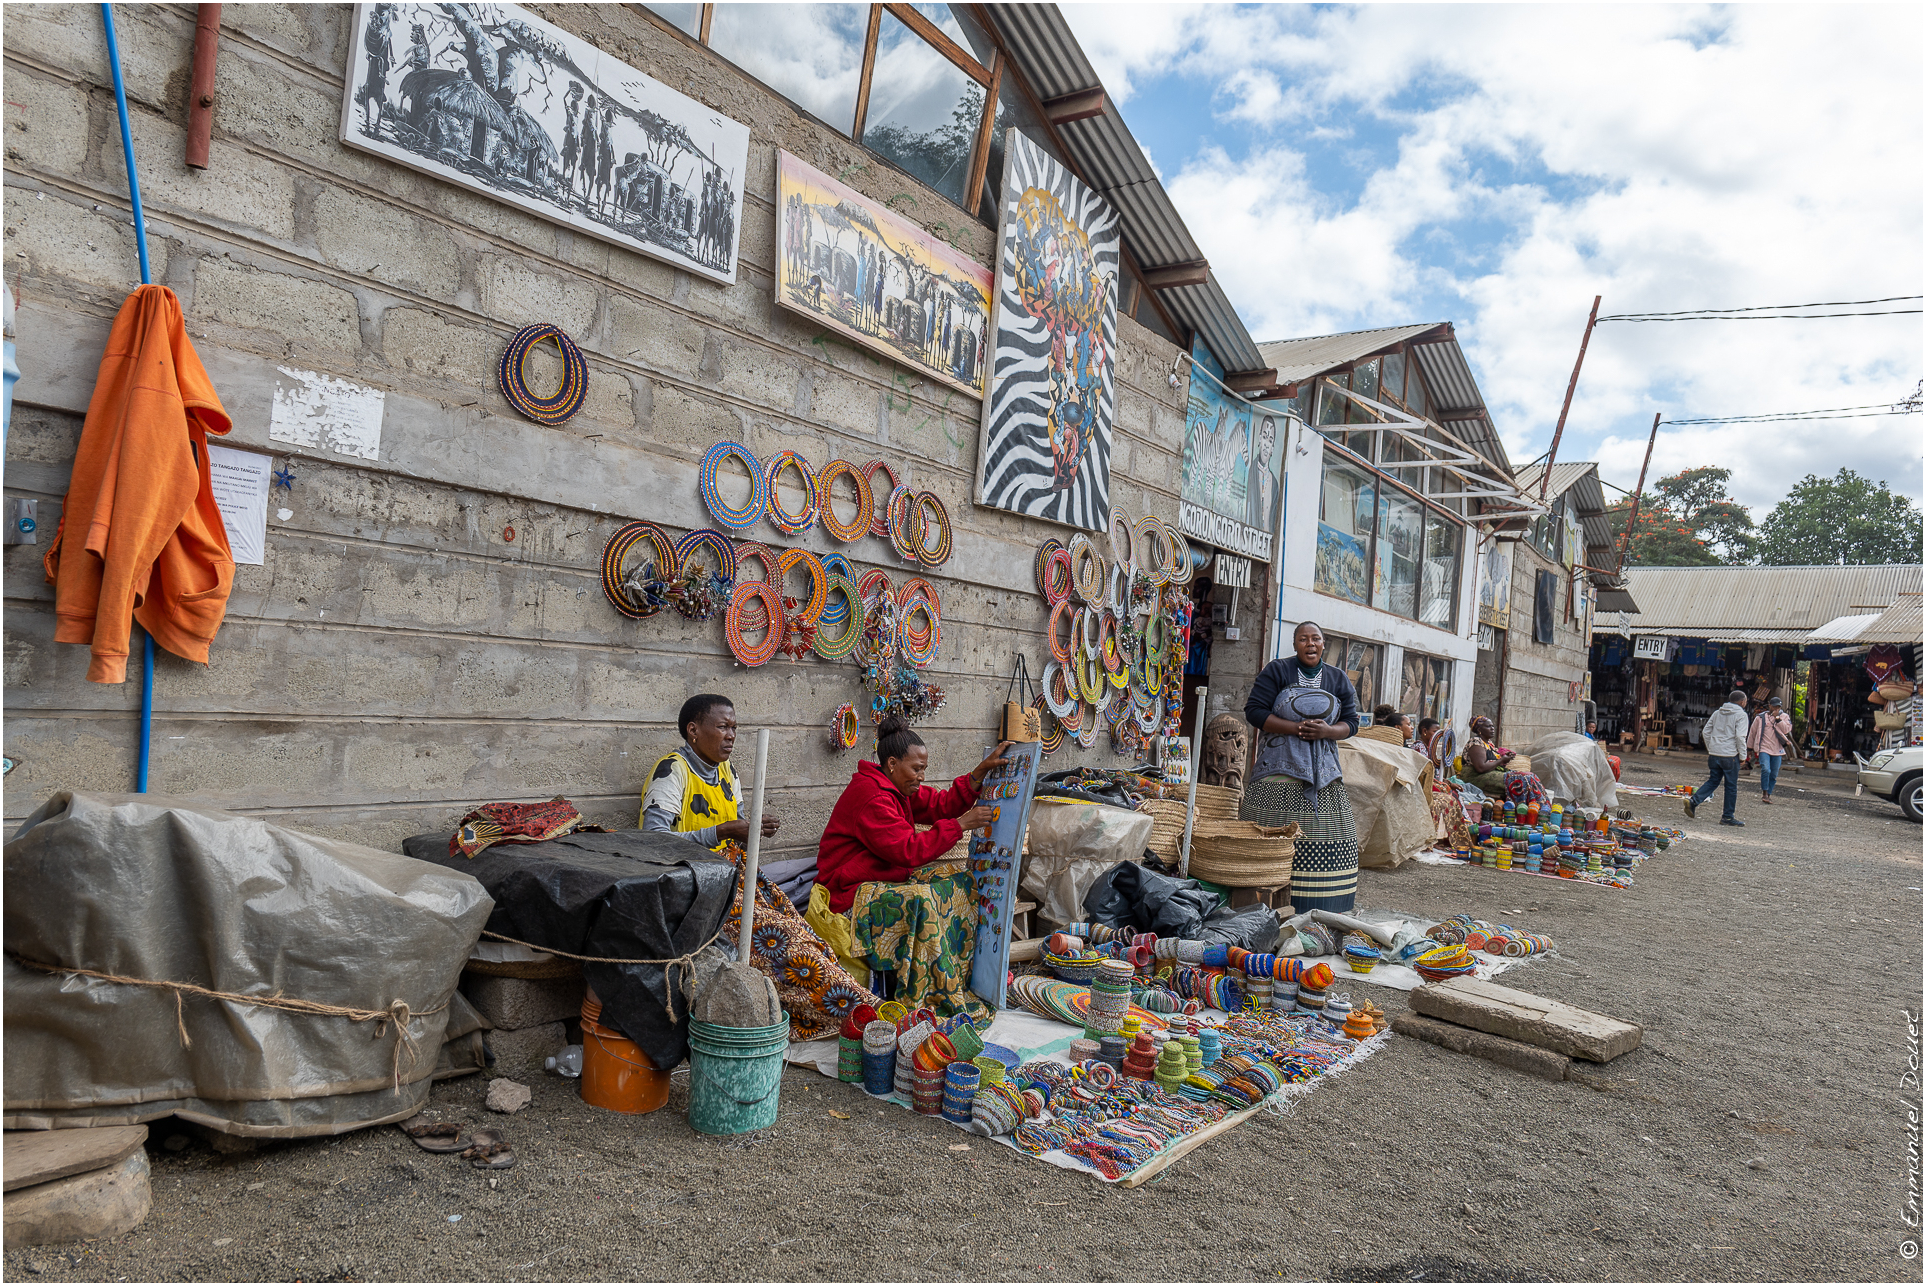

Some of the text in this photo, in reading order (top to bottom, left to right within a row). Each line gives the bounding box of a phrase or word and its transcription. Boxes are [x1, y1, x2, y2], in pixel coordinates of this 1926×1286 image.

[218, 463, 240, 472] TANGAZO
[240, 467, 262, 475] TANGAZO
[1179, 500, 1273, 560] NGORONGORO STREET
[1219, 557, 1249, 586] ENTRY
[1638, 639, 1665, 653] ENTRY
